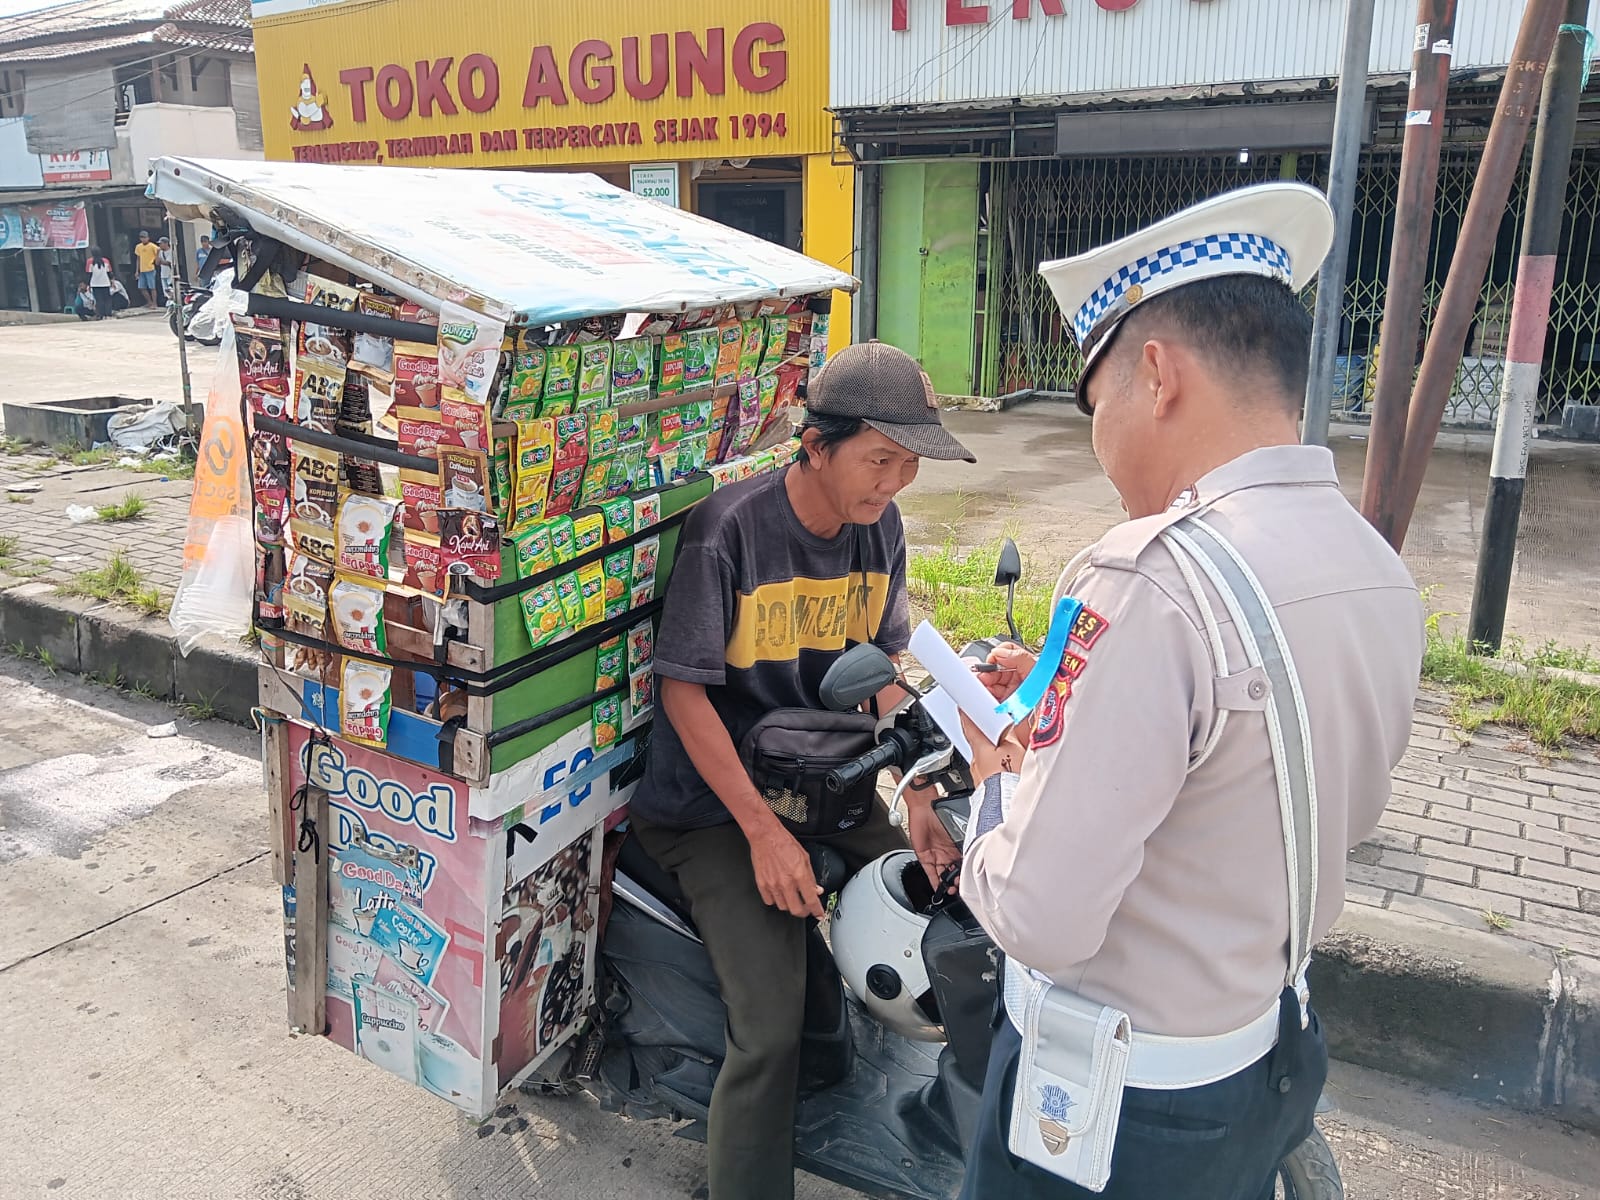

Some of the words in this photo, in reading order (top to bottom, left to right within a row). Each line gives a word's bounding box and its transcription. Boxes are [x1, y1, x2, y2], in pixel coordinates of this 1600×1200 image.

[339, 52, 500, 123] TOKO
[523, 22, 788, 108] AGUNG
[385, 132, 473, 159] TERMURAH
[480, 129, 518, 153] DAN
[522, 122, 642, 149] TERPERCAYA
[653, 117, 719, 144] SEJAK
[729, 112, 787, 140] 1994
[643, 187, 671, 198] 52.000
[302, 373, 341, 400] ABC
[401, 423, 424, 436] Good
[296, 456, 336, 482] ABC
[403, 485, 425, 498] Good
[424, 489, 440, 505] Day
[345, 545, 380, 556] Cappuccino
[449, 535, 475, 554] Kapal
[474, 540, 490, 555] Api
[359, 725, 383, 739] Good
[300, 738, 457, 843] Good
[342, 862, 384, 884] Good
[361, 1013, 406, 1032] Cappuccino
